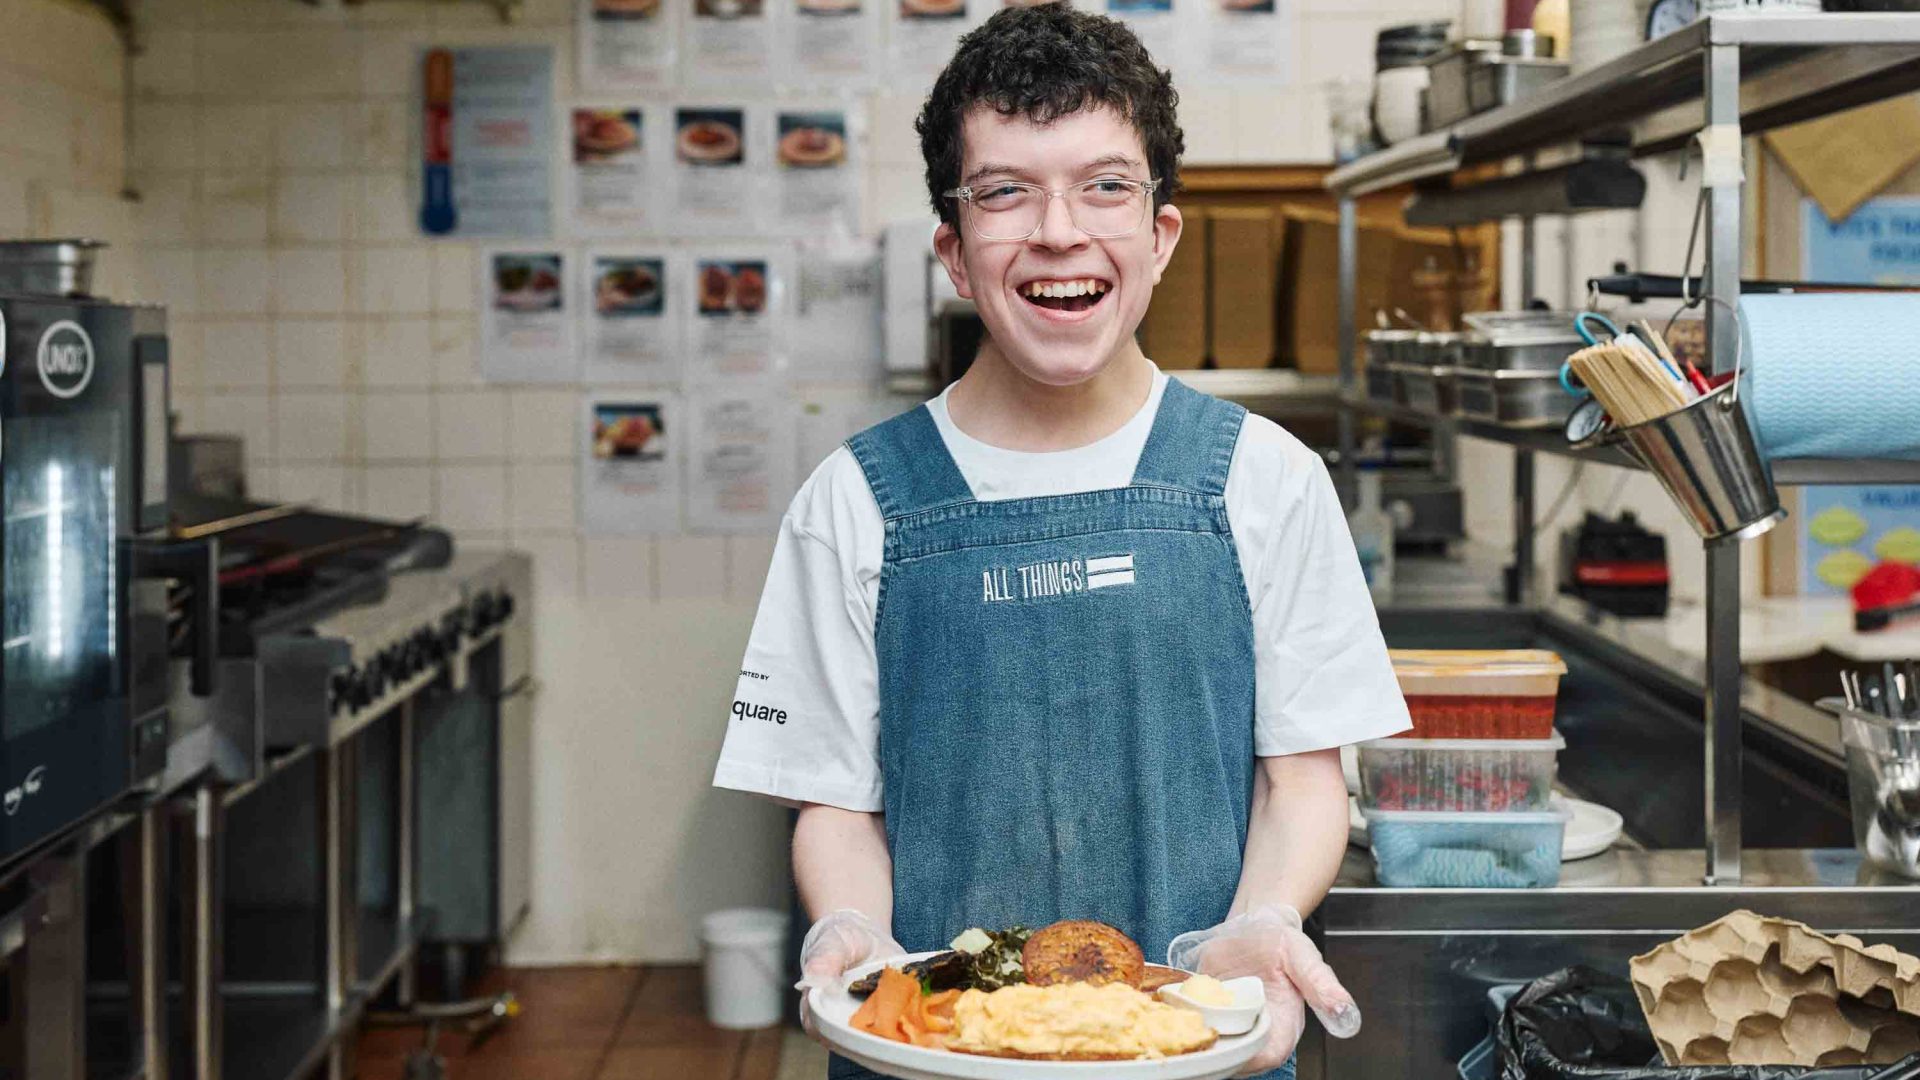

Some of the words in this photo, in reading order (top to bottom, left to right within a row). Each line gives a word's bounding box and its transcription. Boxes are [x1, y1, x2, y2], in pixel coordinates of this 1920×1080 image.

[43, 344, 84, 374] UNOX
[983, 569, 1013, 601] ALL
[1017, 560, 1082, 598] THINGS
[732, 700, 787, 724] quare
